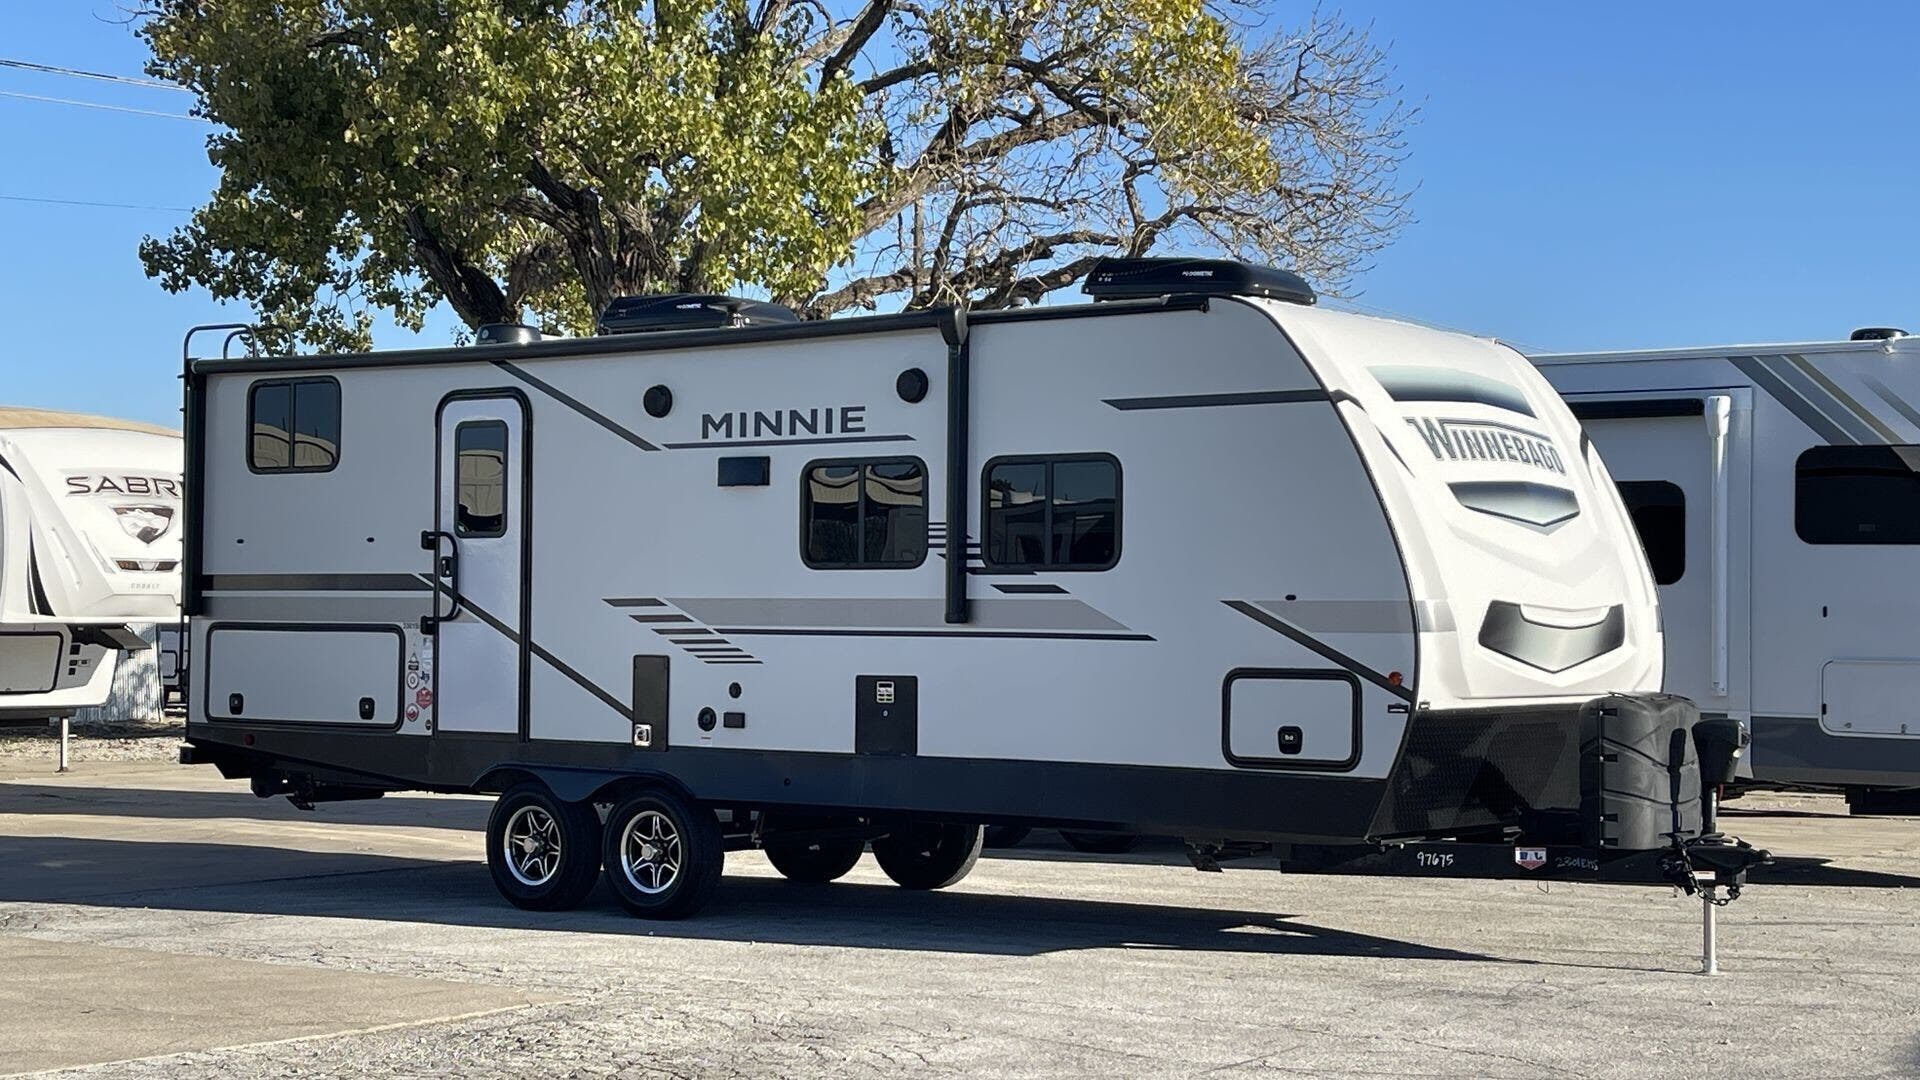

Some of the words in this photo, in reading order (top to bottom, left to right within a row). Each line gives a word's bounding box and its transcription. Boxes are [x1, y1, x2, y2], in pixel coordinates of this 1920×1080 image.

[702, 406, 866, 440] MINNIE
[1404, 416, 1567, 475] WINNEBAGO
[66, 475, 184, 496] SABR
[1416, 851, 1454, 868] 97675
